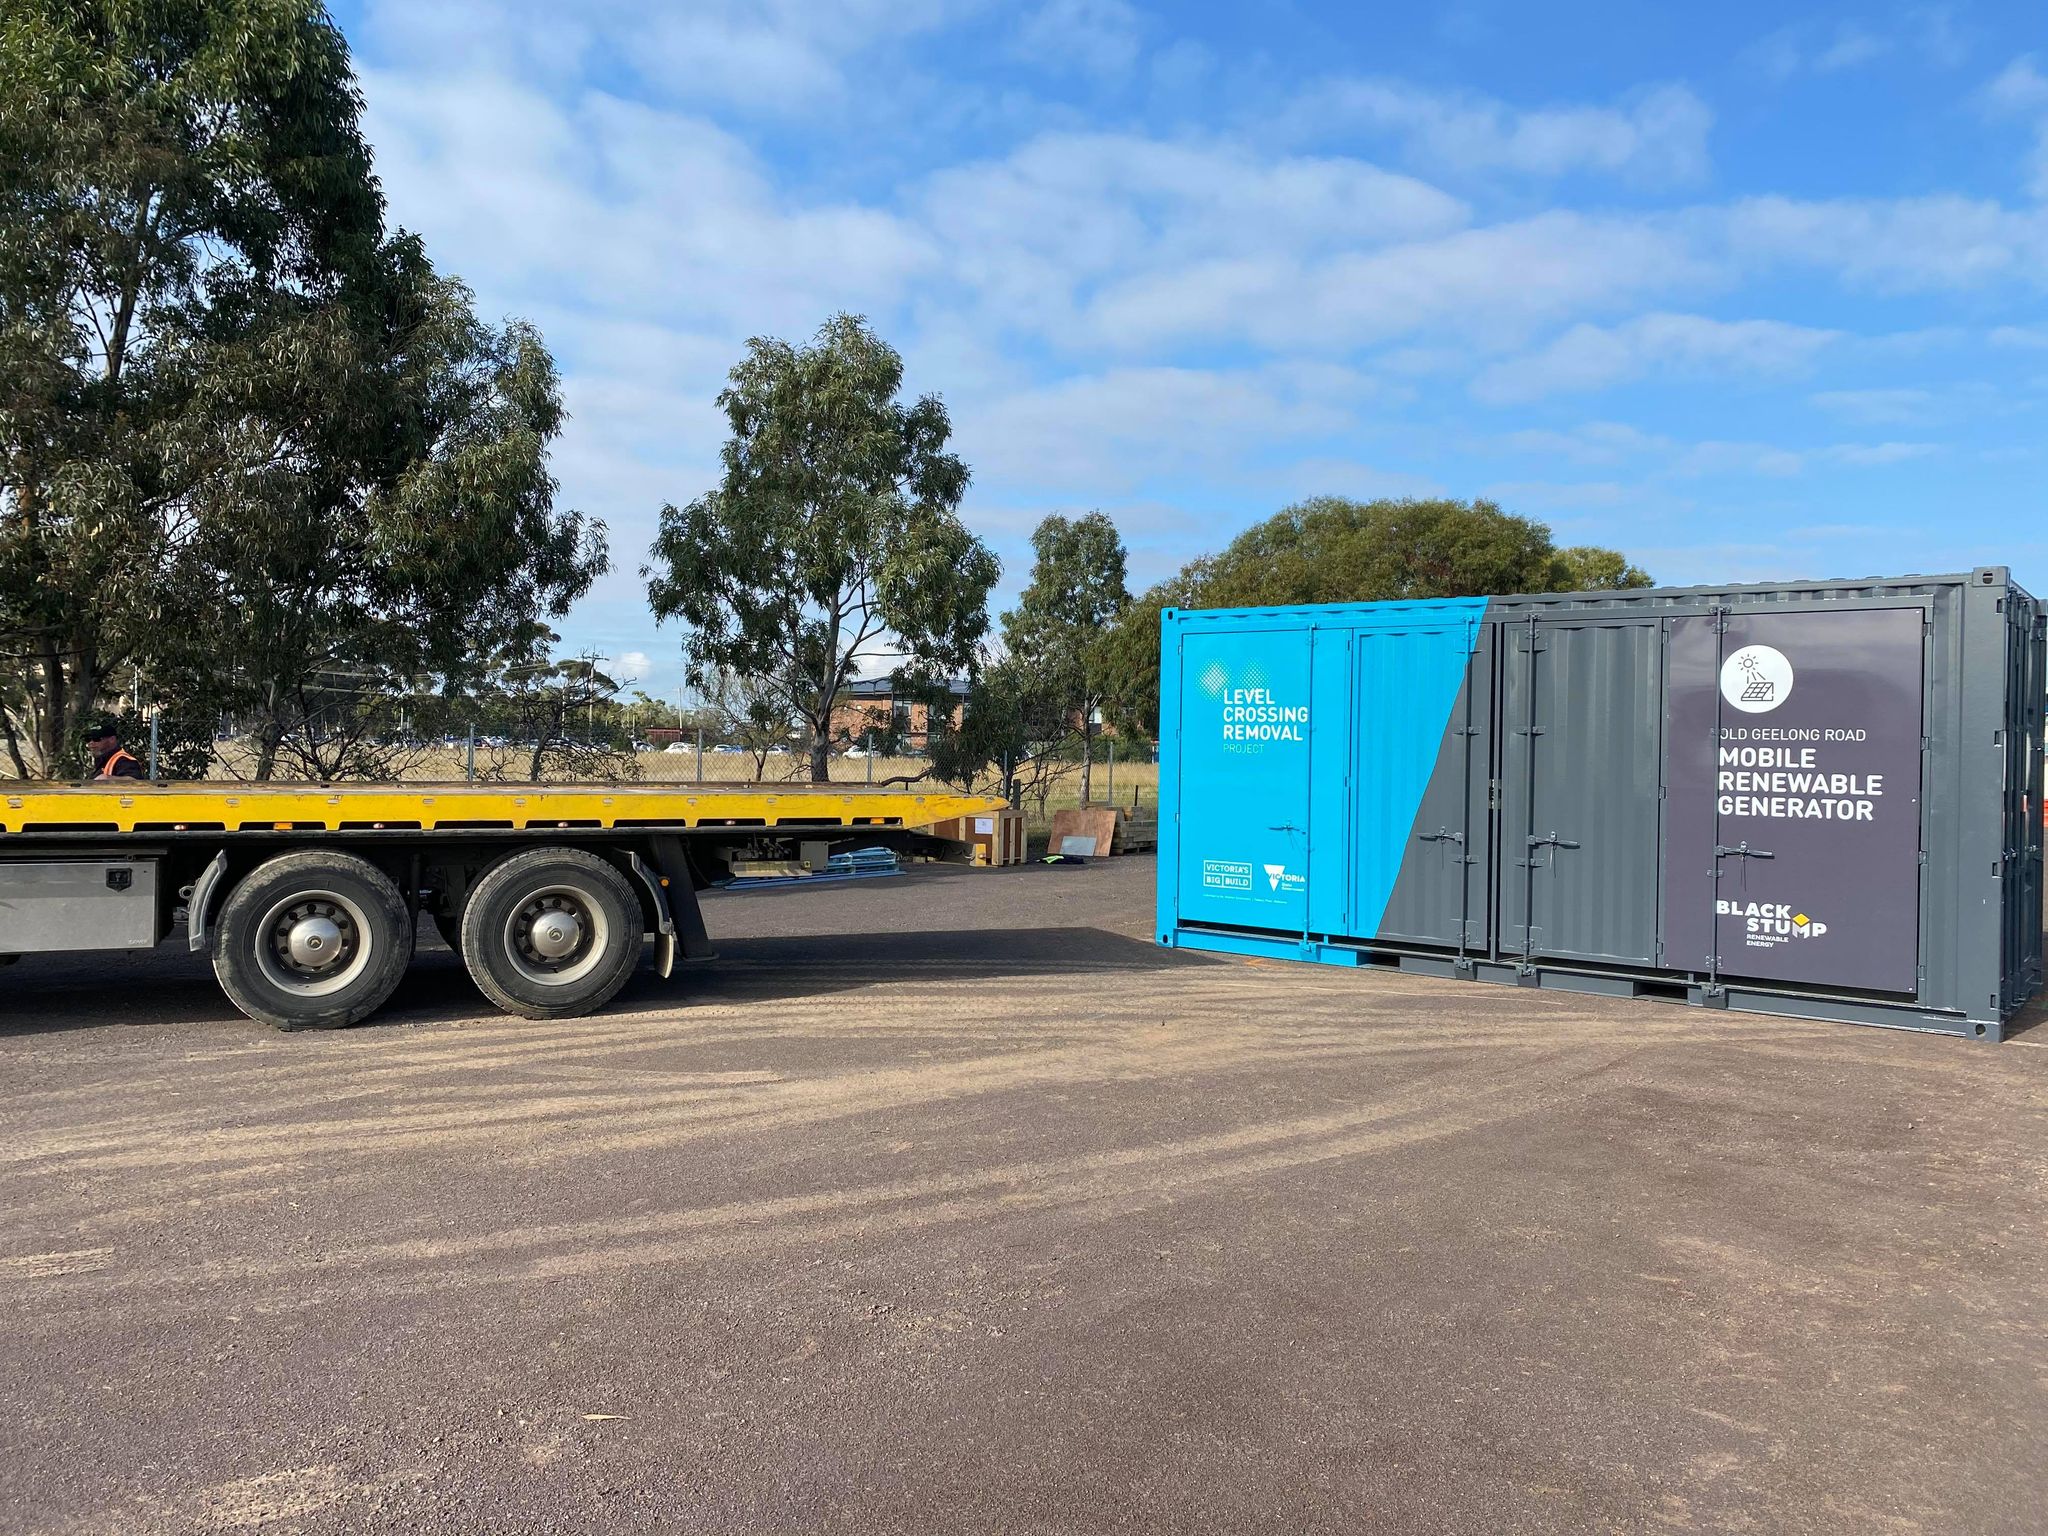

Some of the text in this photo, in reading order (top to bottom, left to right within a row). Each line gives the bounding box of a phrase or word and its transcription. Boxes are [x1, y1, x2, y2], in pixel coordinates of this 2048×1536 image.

[1223, 688, 1275, 705] LEVEL
[1223, 706, 1308, 723] CROSSING
[1223, 724, 1304, 741] REMOVAL
[1720, 728, 1866, 742] OLD GEELONG ROAD
[1223, 743, 1265, 754] PROJECT
[1719, 746, 1817, 768] MOBILE
[1718, 771, 1884, 796] RENEWABLE
[1718, 795, 1874, 821] GENERATOR
[1206, 863, 1249, 874] VICTORIA'S
[1206, 876, 1249, 887] BIG BUILD
[1268, 873, 1306, 883] VICTORIA
[1716, 900, 1792, 920] BLACK
[1746, 917, 1827, 939] STUMP
[1746, 933, 1789, 943] RENEWABLE
[1746, 940, 1774, 948] ENERGY
